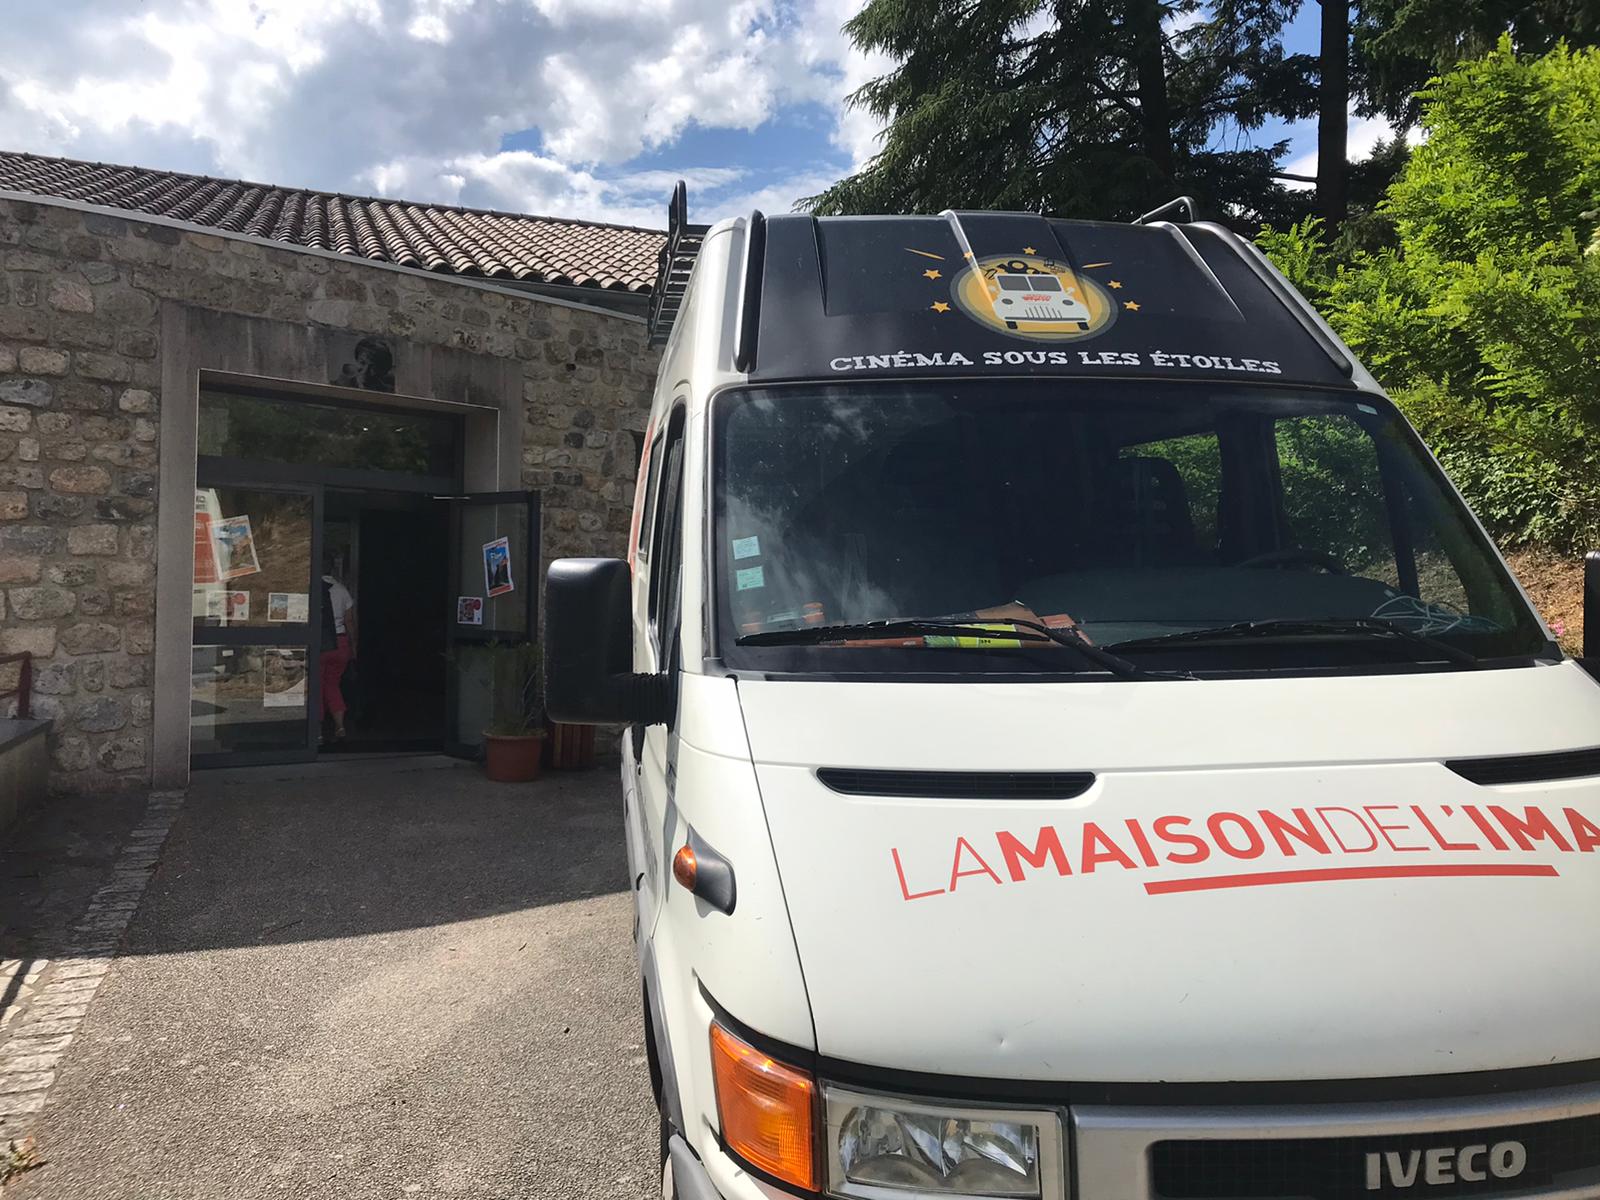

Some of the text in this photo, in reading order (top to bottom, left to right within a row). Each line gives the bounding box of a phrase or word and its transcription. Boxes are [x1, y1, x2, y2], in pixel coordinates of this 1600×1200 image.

[829, 350, 1282, 374] CINÉMA SOUS LES ÉTOILES
[1365, 1140, 1528, 1190] IVECO
